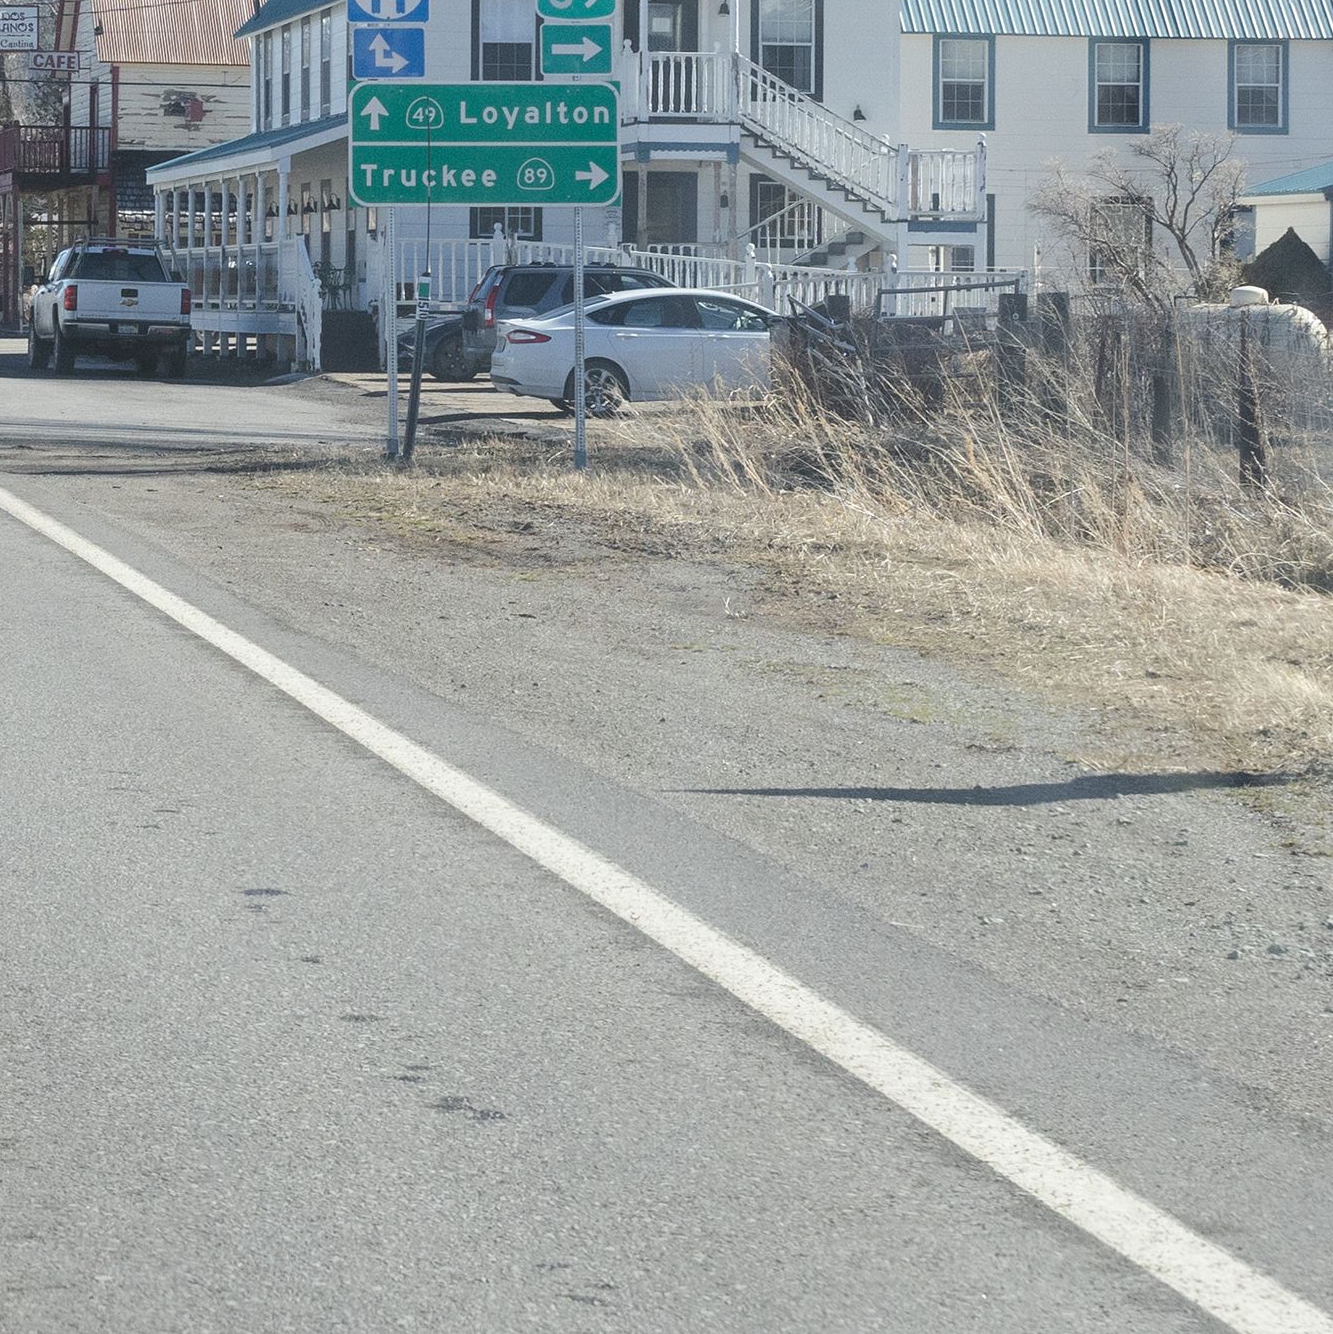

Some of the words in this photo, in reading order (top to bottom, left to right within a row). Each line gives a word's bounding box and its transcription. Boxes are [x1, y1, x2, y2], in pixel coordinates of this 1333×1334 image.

[1, 12, 25, 21] DOS
[0, 39, 33, 48] Cantina
[33, 54, 76, 69] CAFE
[412, 107, 436, 123] 49
[460, 101, 610, 130] Loyalton
[360, 164, 497, 187] Truckee
[524, 168, 548, 184] 89
